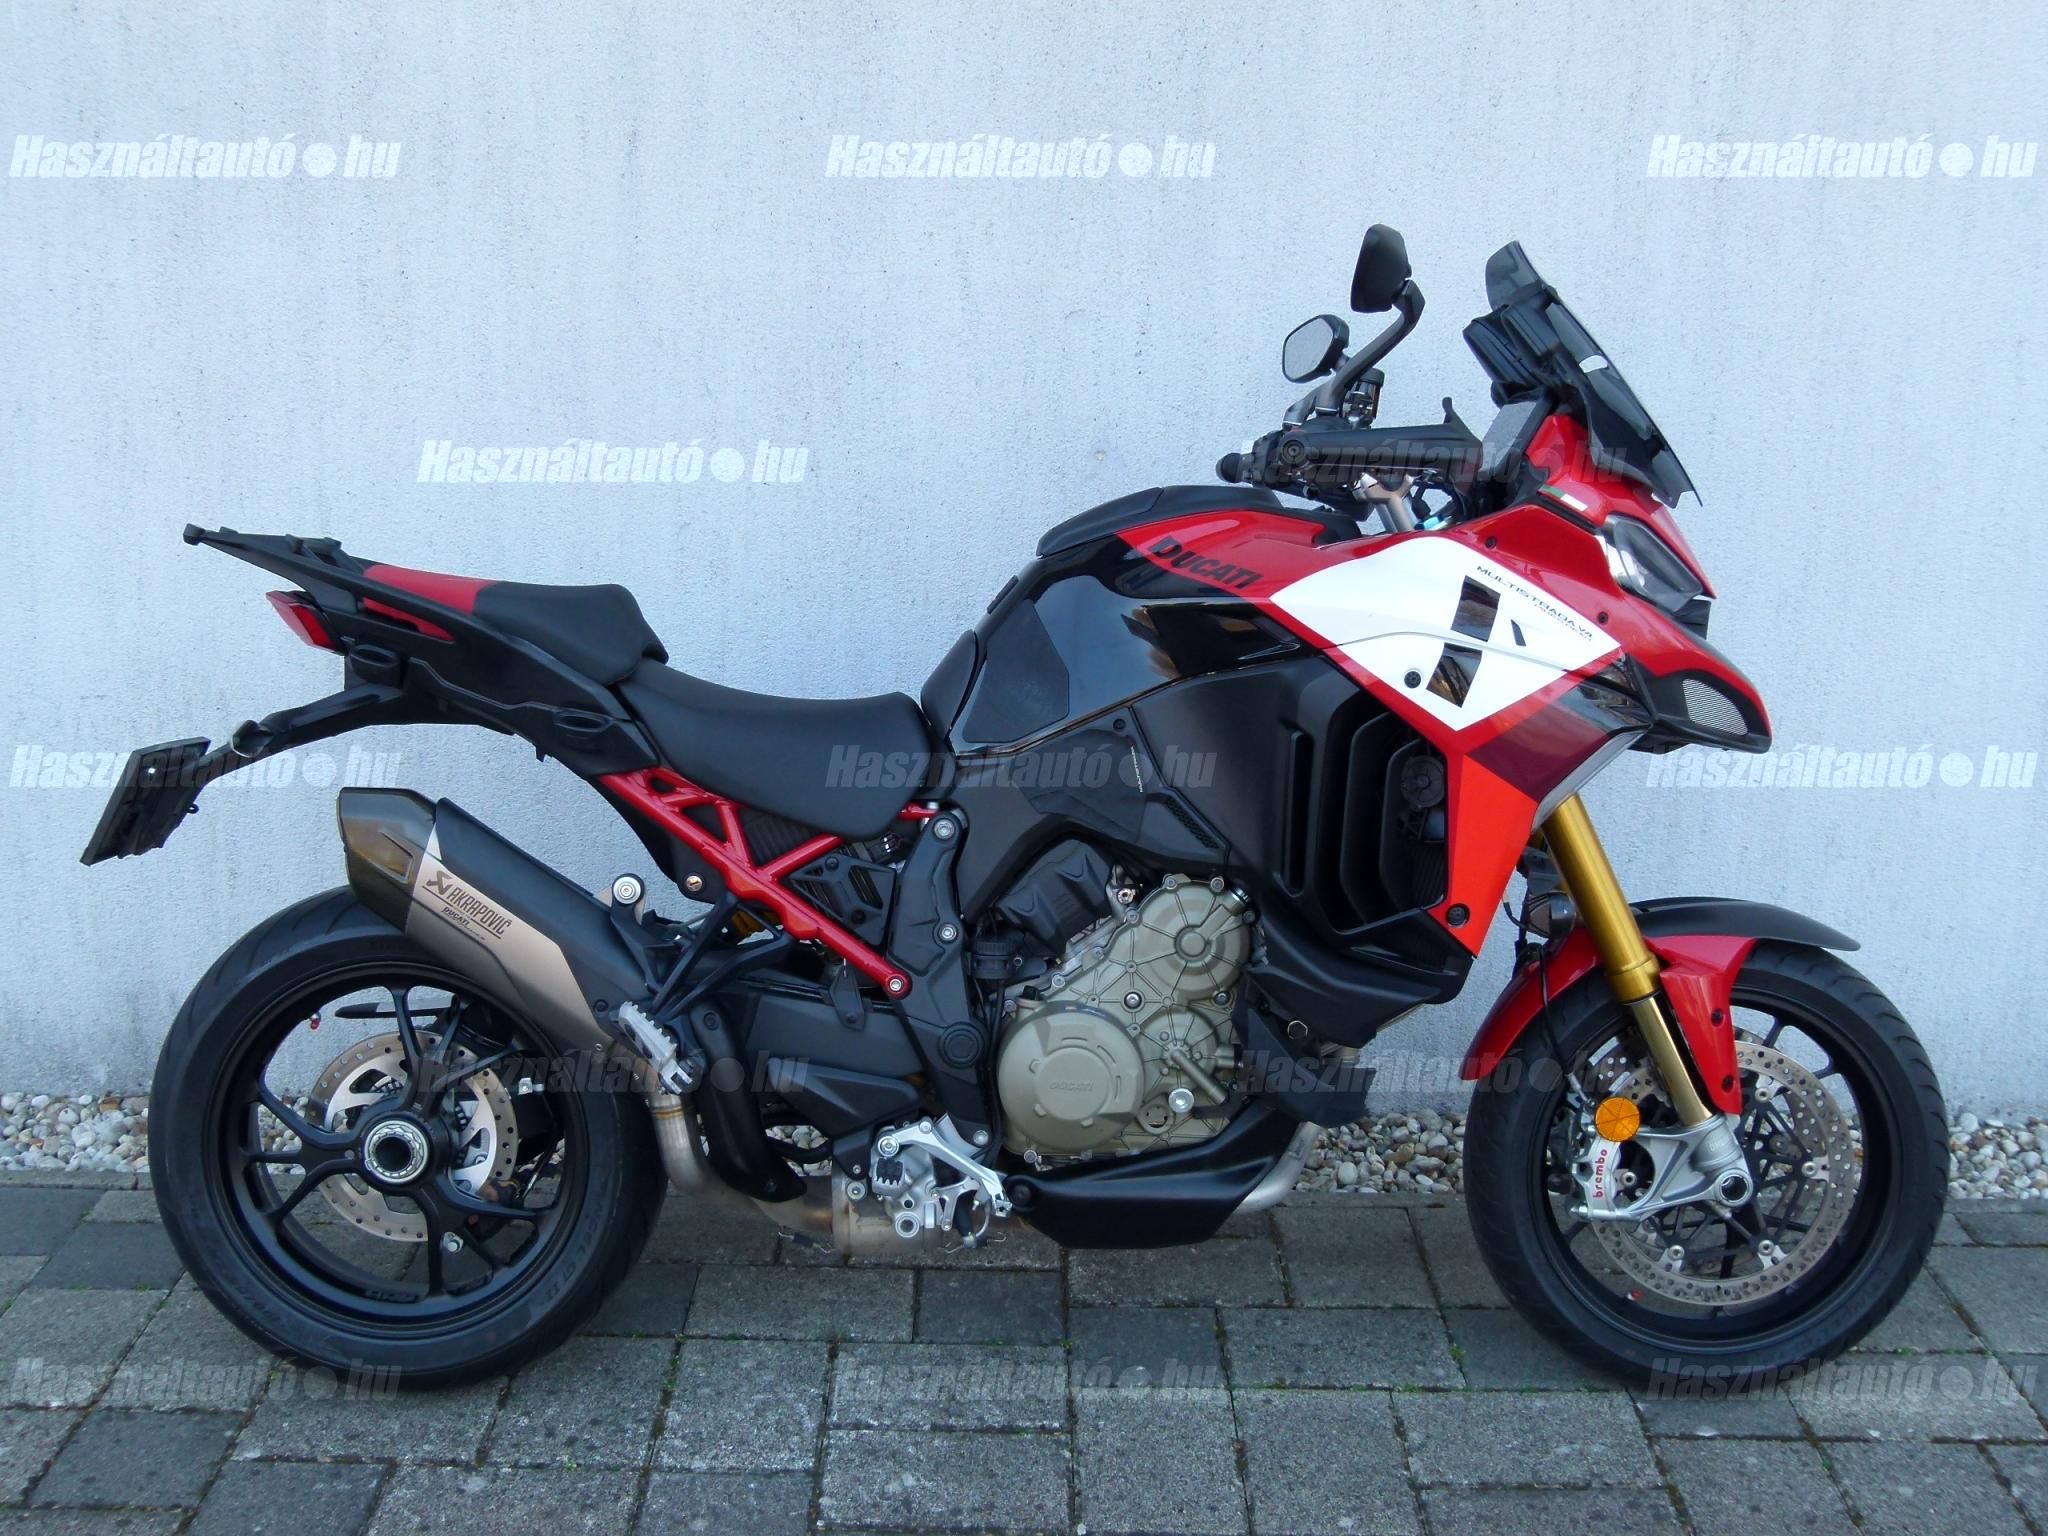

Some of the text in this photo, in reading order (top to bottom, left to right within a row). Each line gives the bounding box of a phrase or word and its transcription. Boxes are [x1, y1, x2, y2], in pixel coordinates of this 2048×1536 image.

[1148, 535, 1264, 589] DUCATI
[1476, 564, 1576, 628] MULTISTRADA
[441, 907, 470, 926] DUCATI
[446, 887, 513, 934] AKRAPOVIČ
[1592, 1149, 1609, 1198] brembo
